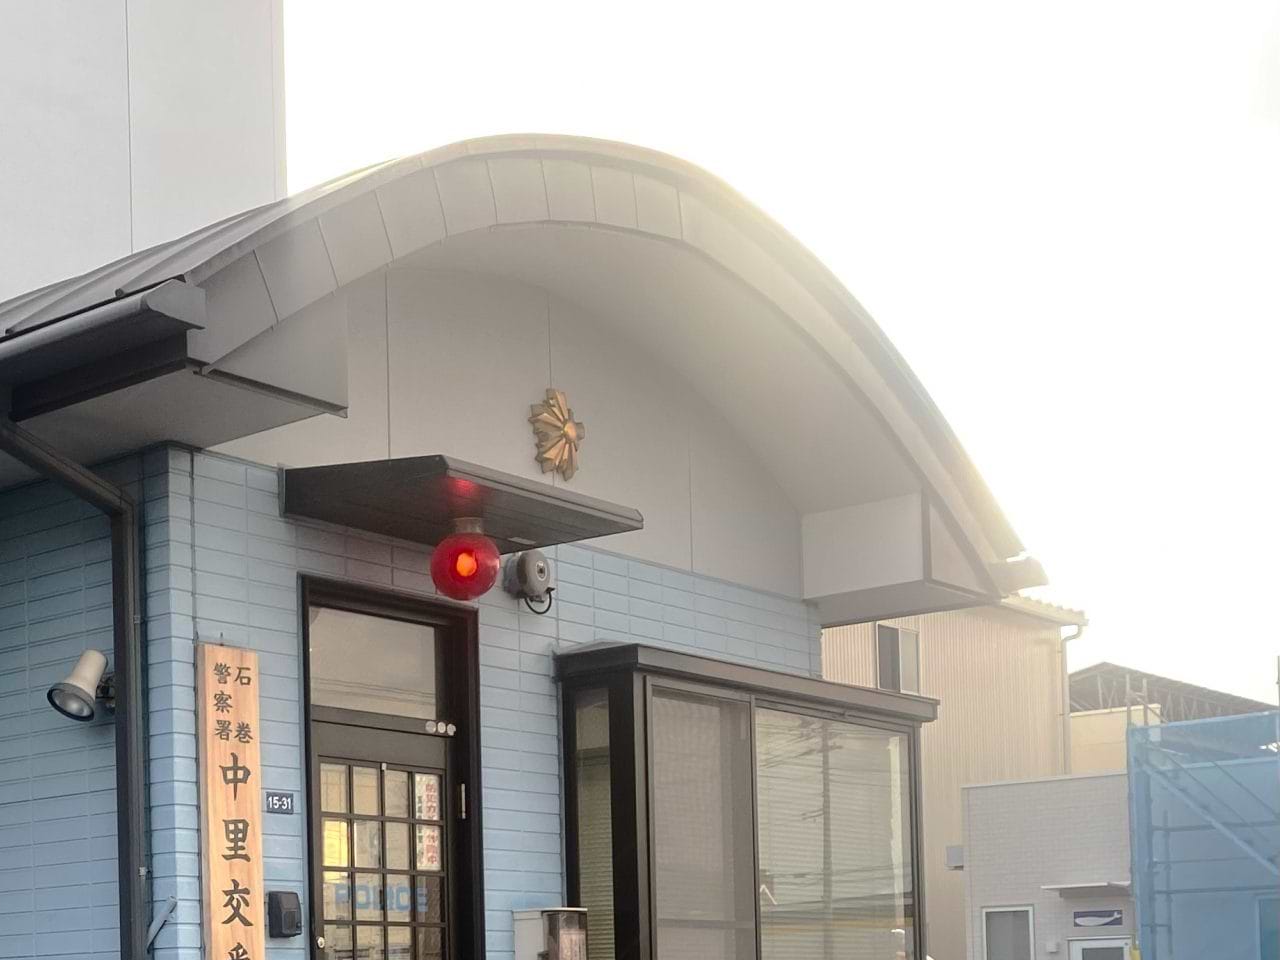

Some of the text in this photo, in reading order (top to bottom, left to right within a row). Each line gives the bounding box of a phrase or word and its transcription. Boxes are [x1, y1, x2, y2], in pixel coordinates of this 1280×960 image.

[213, 662, 233, 742] 警察署
[233, 666, 253, 744] 石巻
[268, 796, 292, 810] 15-31
[335, 884, 428, 912] POLICE
